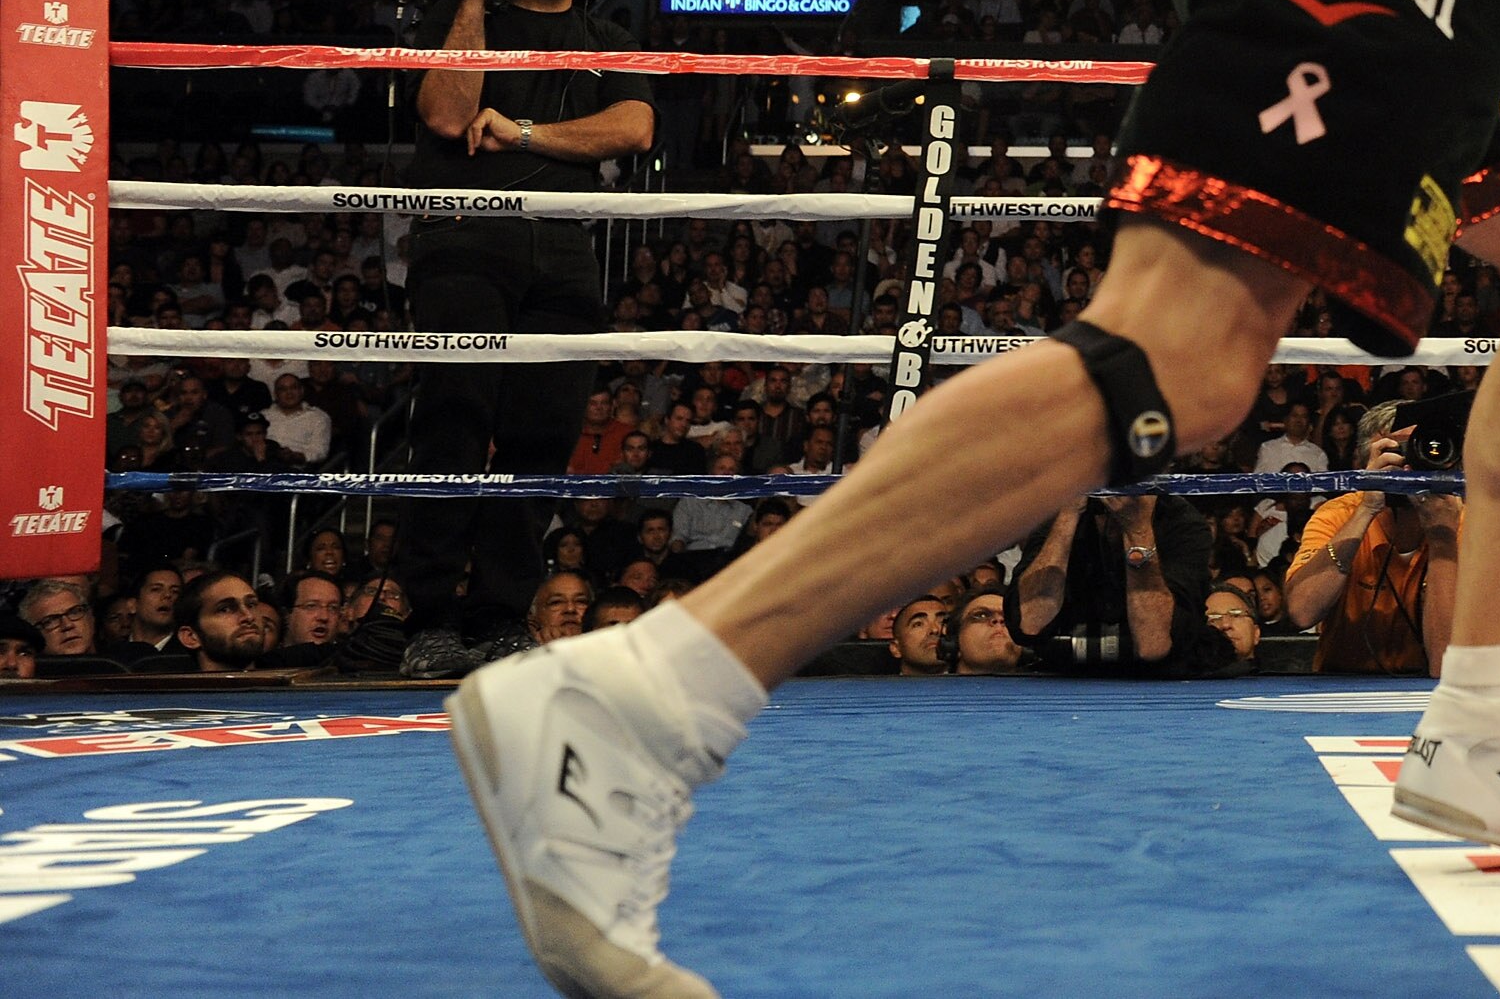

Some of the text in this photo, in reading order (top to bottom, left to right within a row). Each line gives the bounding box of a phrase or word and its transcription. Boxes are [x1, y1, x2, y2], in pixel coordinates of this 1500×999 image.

[17, 24, 95, 49] TECATE
[333, 192, 523, 211] SOUTHWEST.COM
[20, 182, 92, 426] TECATE
[314, 332, 508, 350] SOUTHWEST.COM
[889, 351, 921, 426] BO
[10, 510, 91, 537] TECATE
